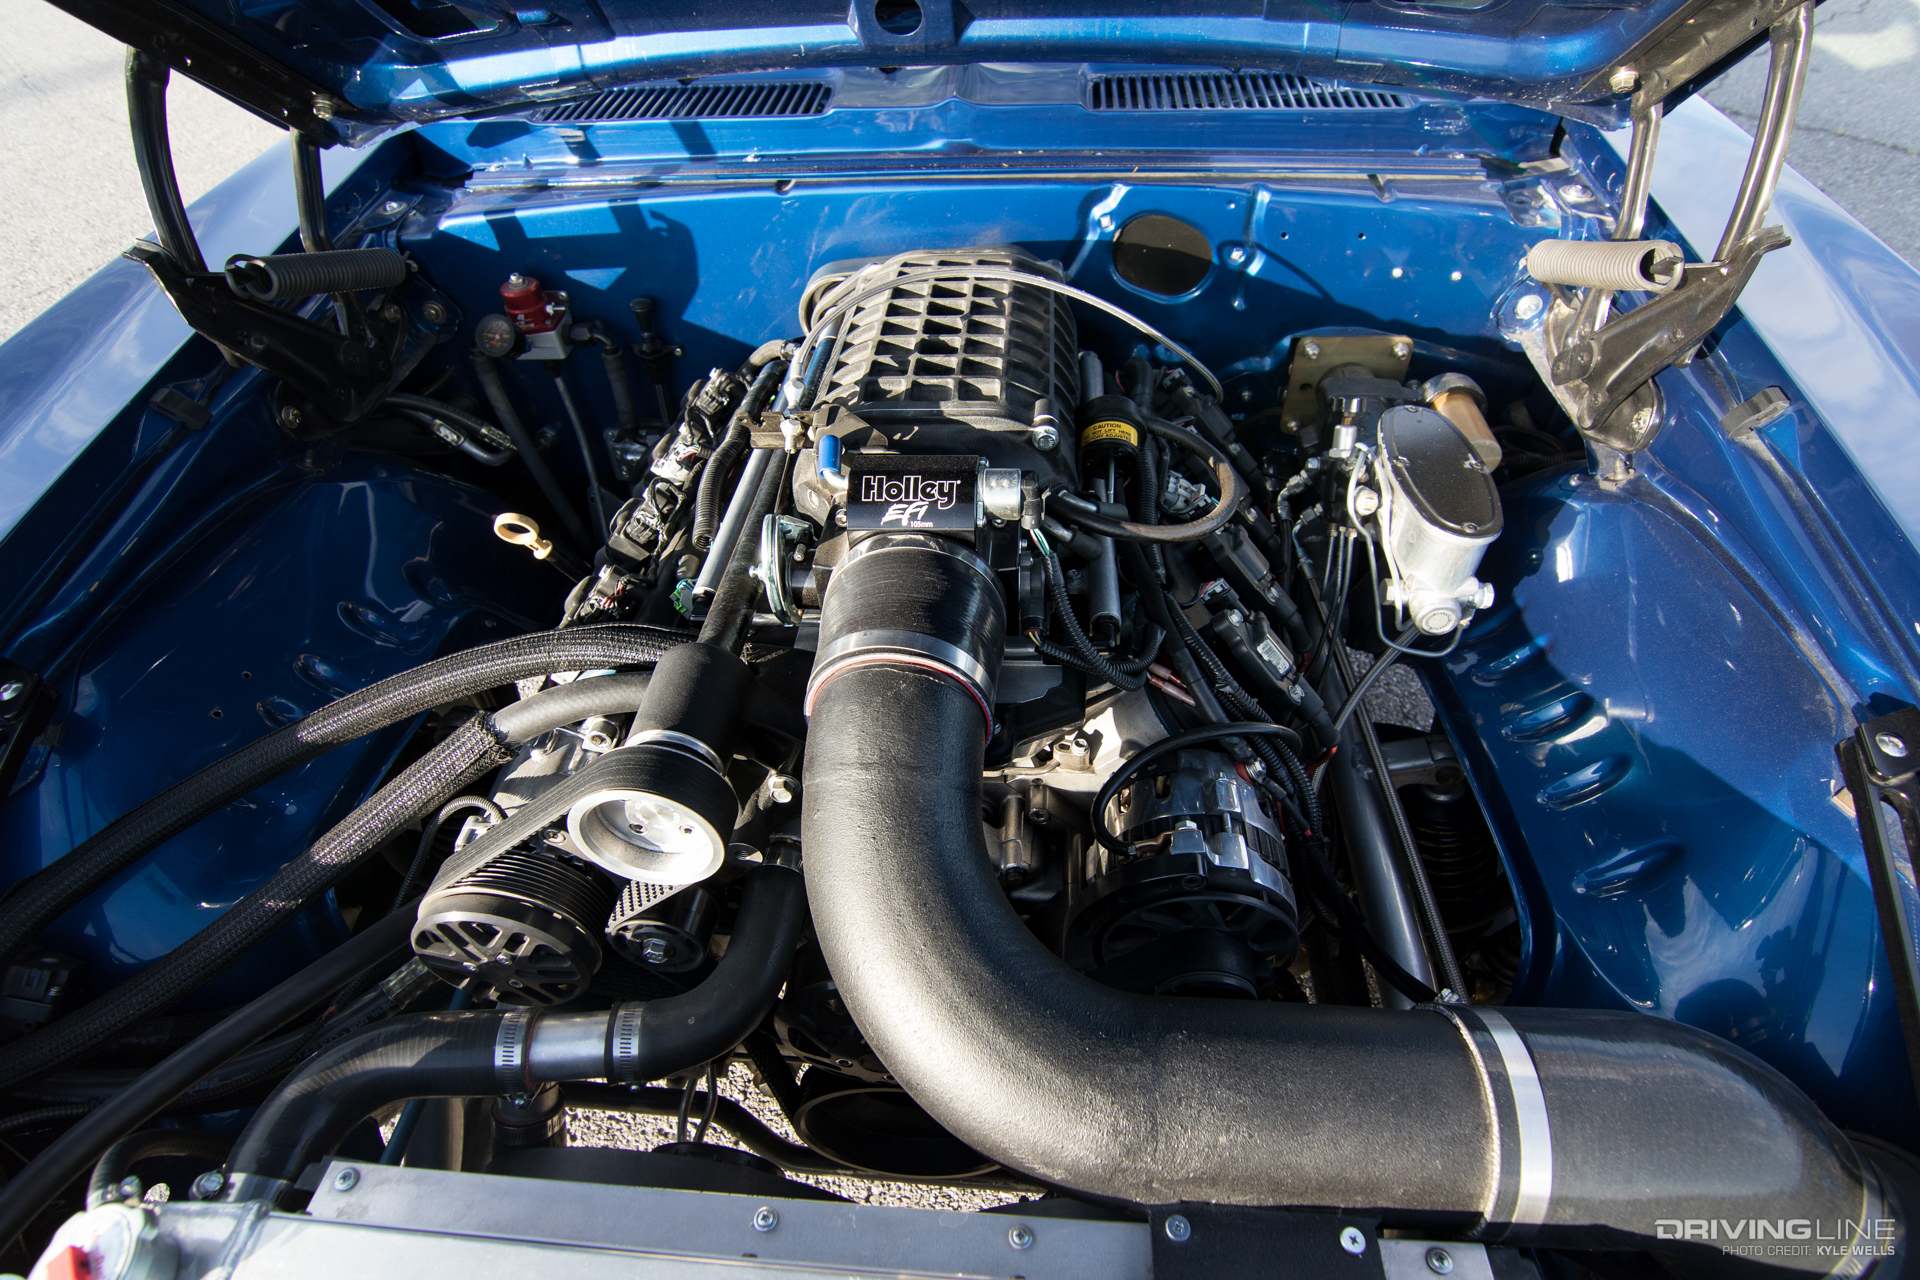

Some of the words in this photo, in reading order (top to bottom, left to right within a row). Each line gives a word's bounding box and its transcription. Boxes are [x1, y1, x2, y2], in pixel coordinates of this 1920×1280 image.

[862, 475, 957, 510] Holley
[880, 501, 930, 527] EFI
[910, 520, 934, 528] 105mm
